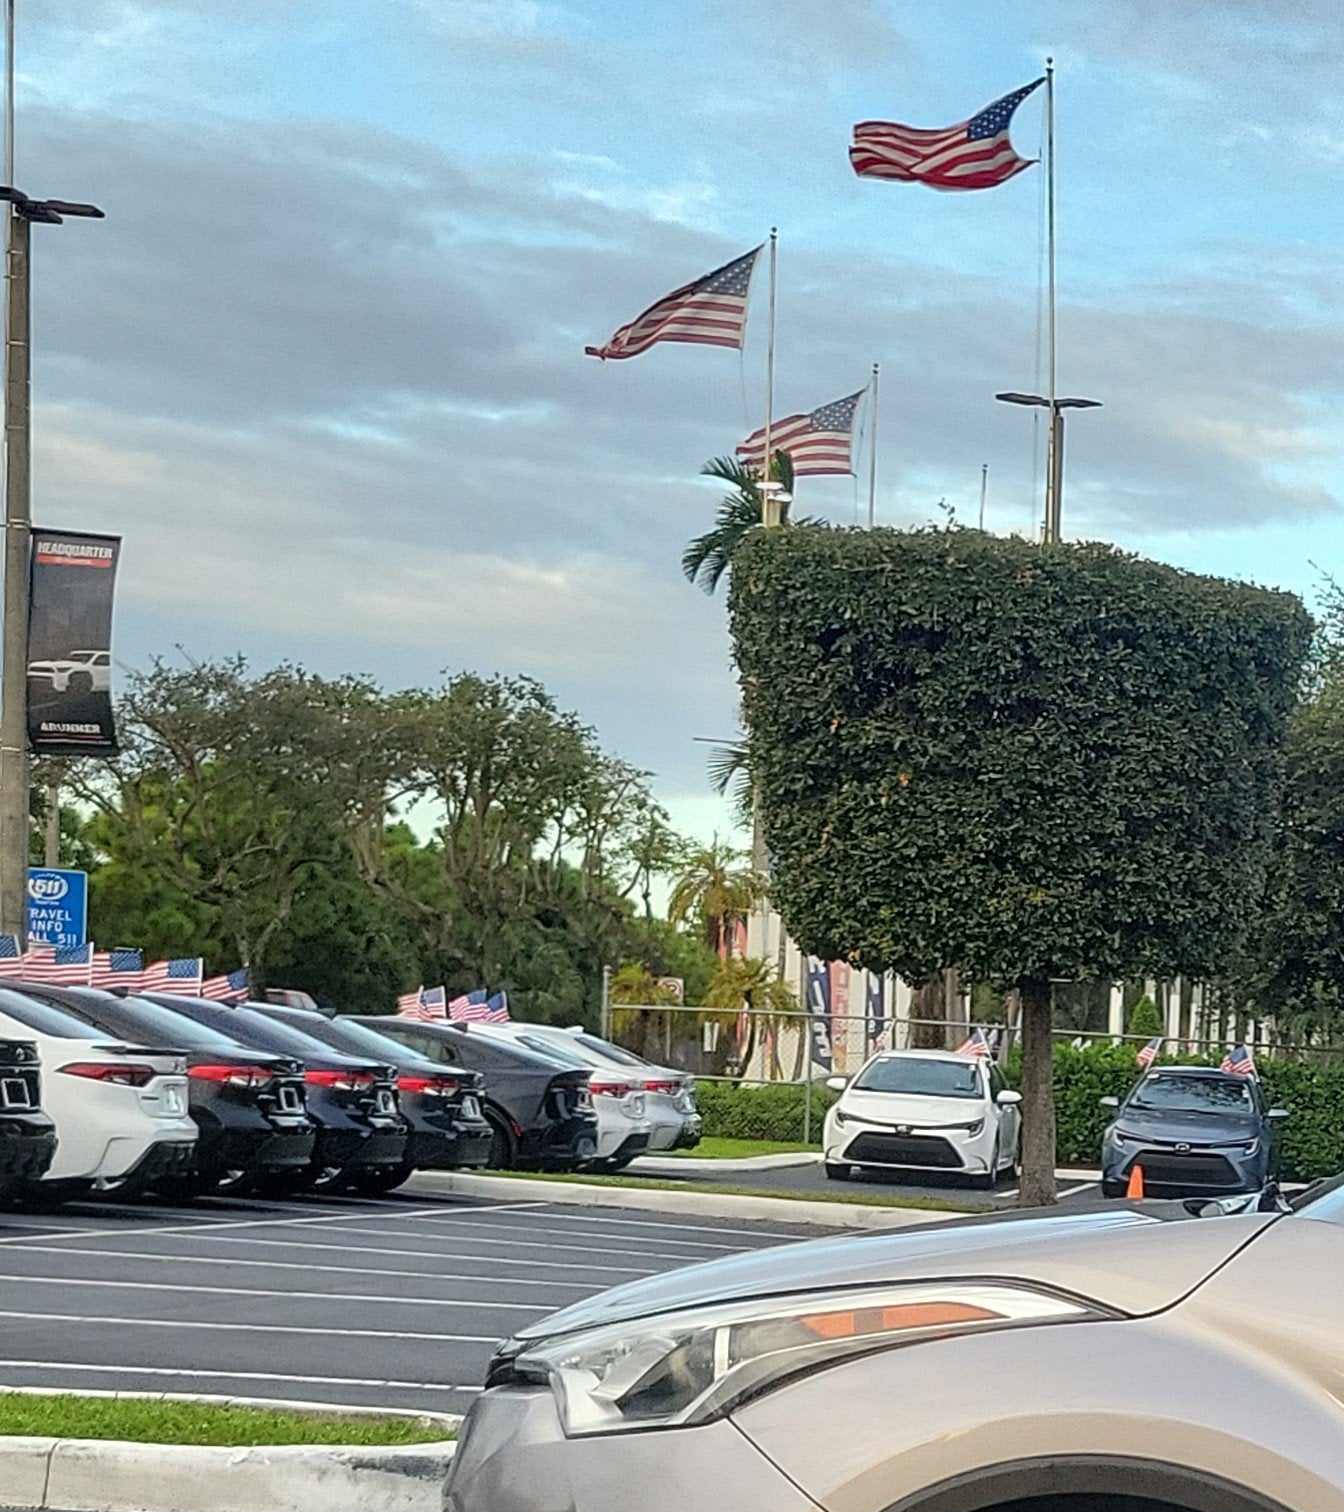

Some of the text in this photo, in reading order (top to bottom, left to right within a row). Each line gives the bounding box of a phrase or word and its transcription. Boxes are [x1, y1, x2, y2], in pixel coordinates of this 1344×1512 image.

[37, 541, 113, 559] HEADQUARTER
[31, 920, 63, 932] INFO
[28, 931, 78, 947] ALL 511
